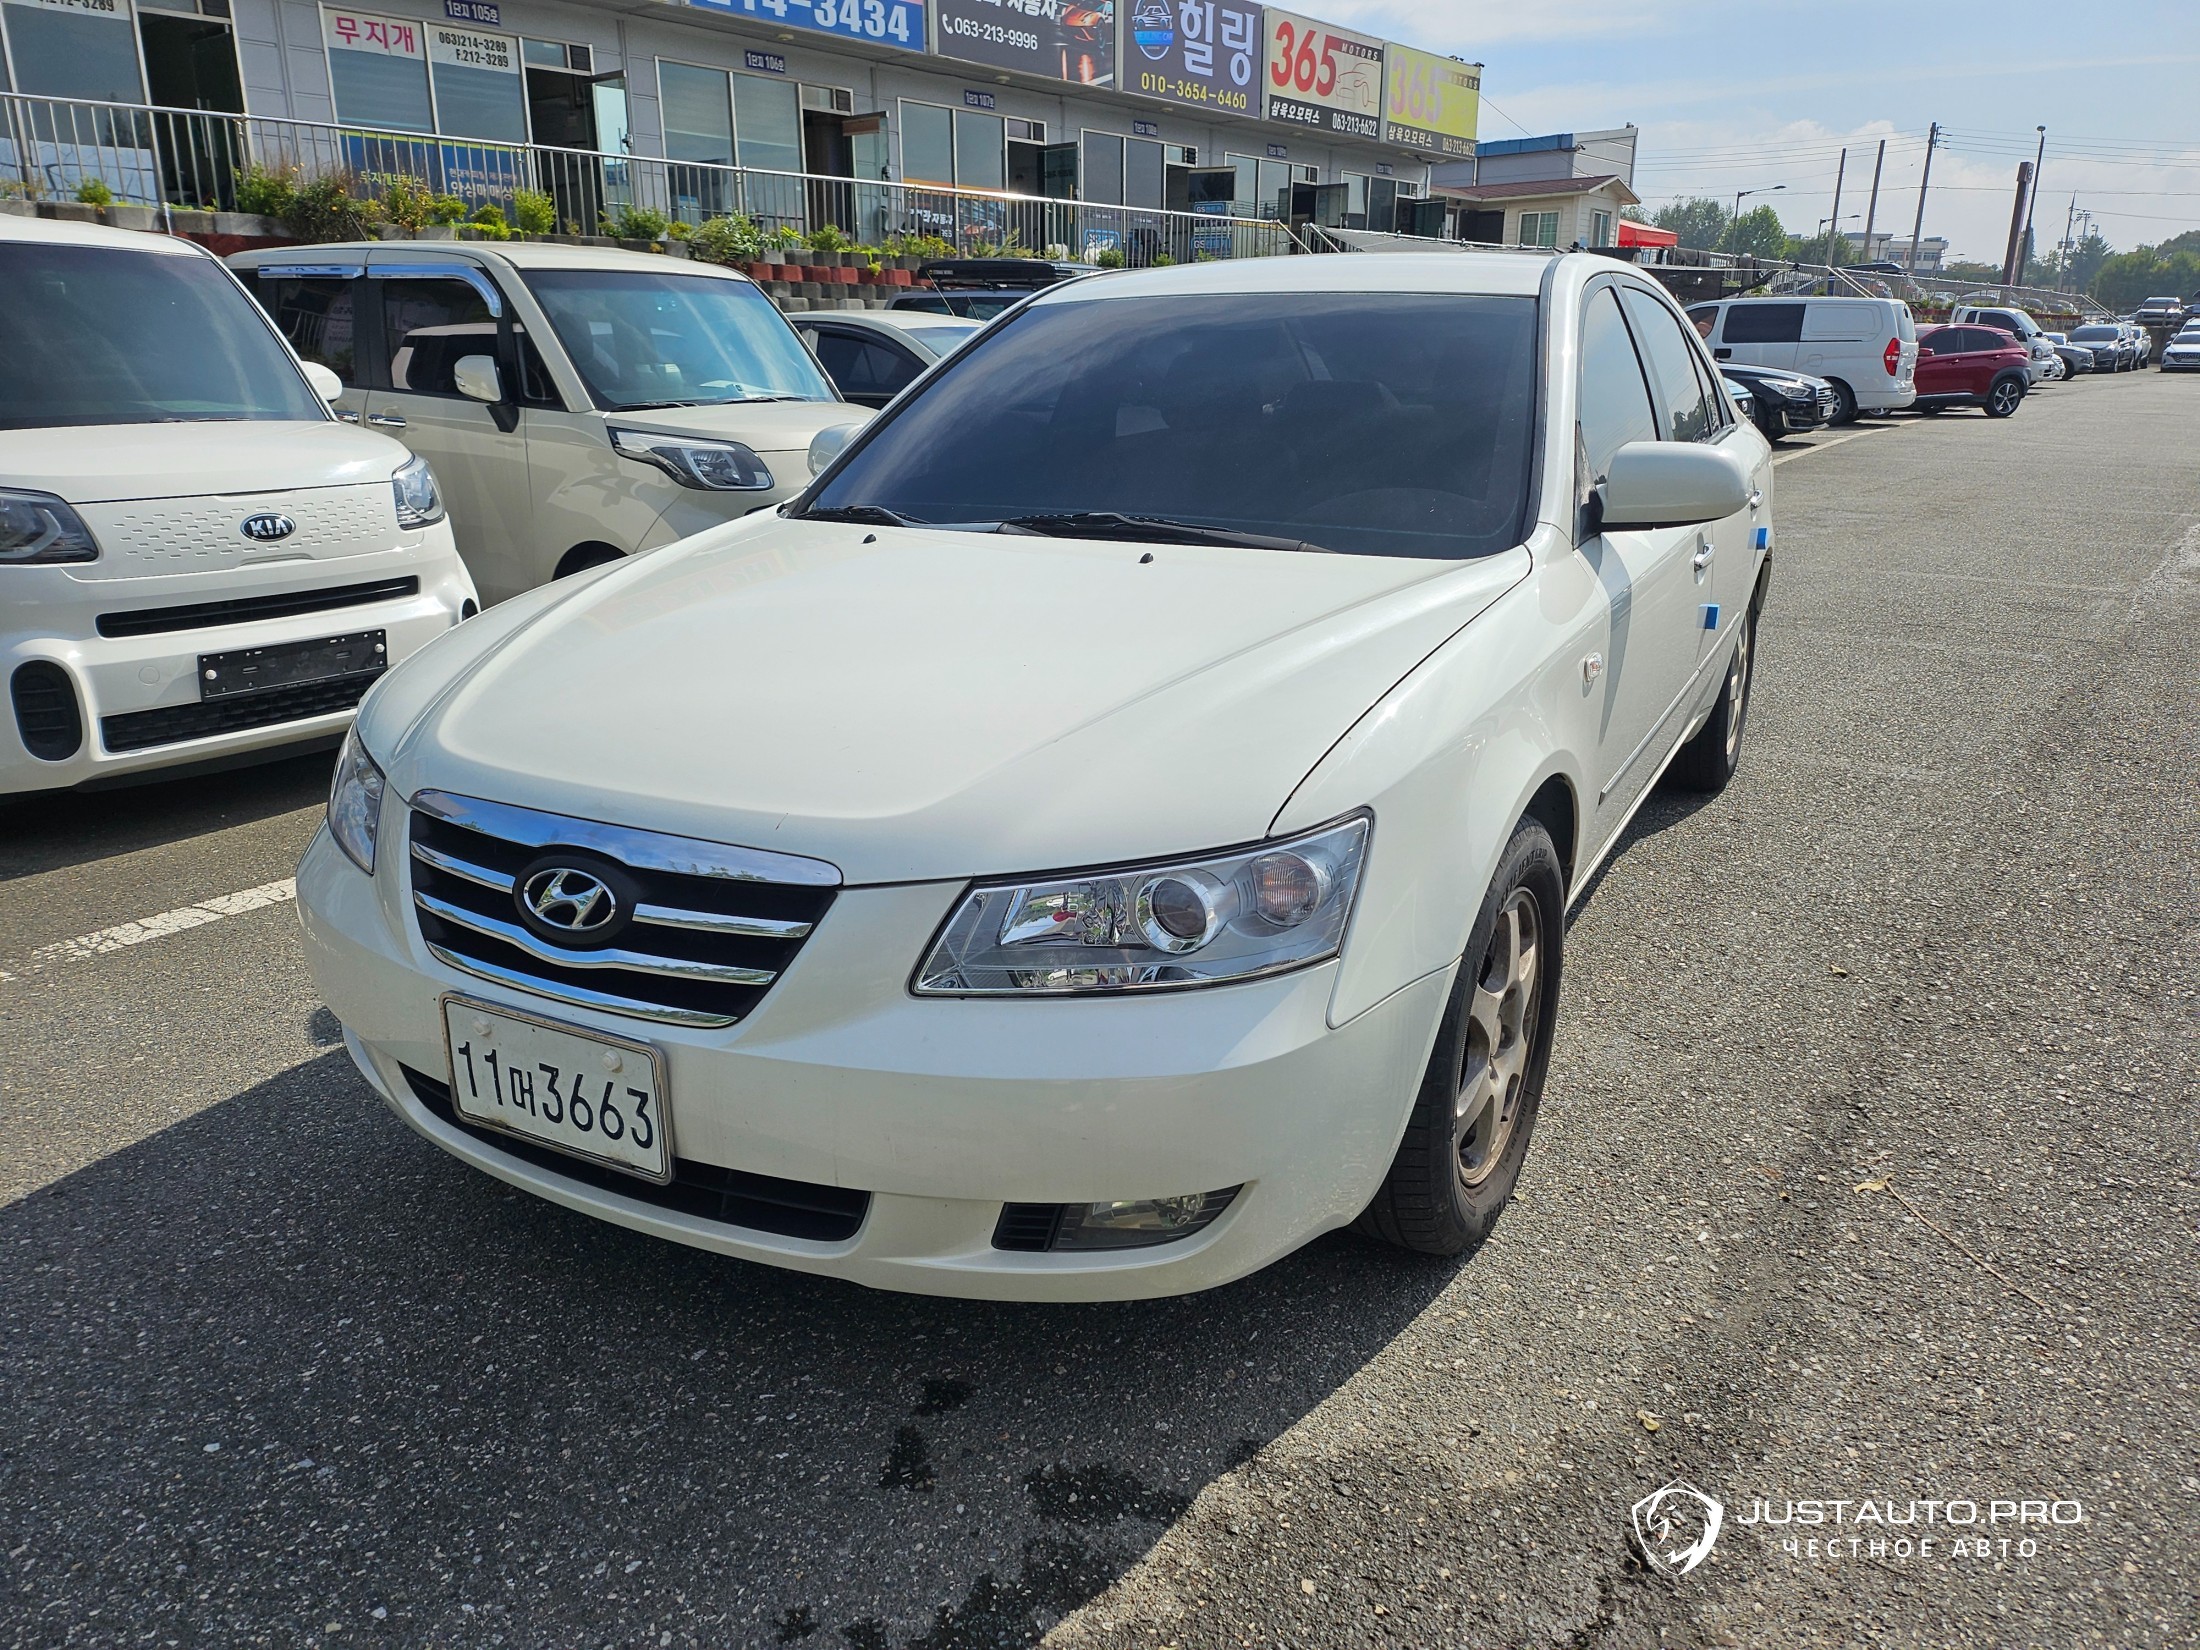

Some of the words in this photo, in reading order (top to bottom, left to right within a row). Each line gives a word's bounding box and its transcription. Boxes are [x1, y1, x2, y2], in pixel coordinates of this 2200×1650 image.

[472, 3, 499, 23] 105호
[335, 16, 415, 53] 무지개
[438, 31, 507, 53] 063)214-3289
[954, 17, 1039, 51] 063-213-9996
[1178, 0, 1256, 86] 힐링
[1341, 43, 1378, 60] MOTORS
[456, 48, 509, 68] F.212-3289
[1271, 20, 1337, 97] 365
[1141, 72, 1247, 110] 010-3654-6460
[1390, 52, 1442, 124] 365
[1271, 101, 1320, 124] 삼육오모터스
[1332, 112, 1378, 137] 063-213-6622
[1388, 125, 1433, 148] 삼육오모터스
[1442, 137, 1476, 157] 063-213-6622
[248, 518, 290, 537] KIA
[457, 1041, 654, 1150] 11머3663
